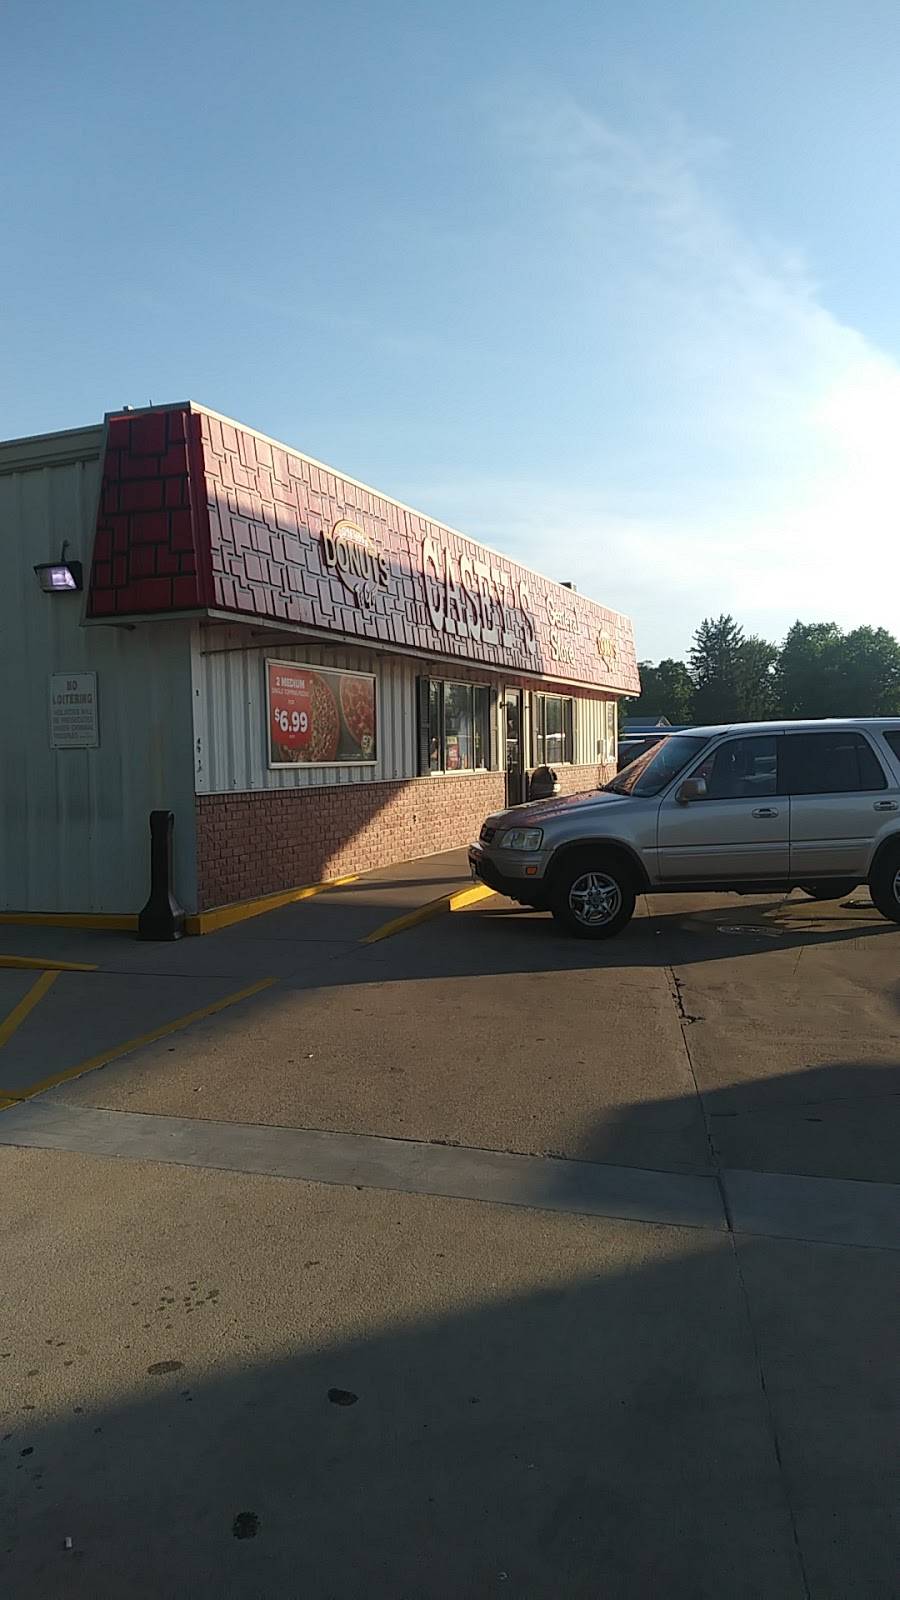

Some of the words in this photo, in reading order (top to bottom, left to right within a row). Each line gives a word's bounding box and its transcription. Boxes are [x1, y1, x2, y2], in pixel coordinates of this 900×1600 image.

[320, 530, 389, 588] DONUTS
[422, 536, 538, 656] CASEY'S
[66, 680, 78, 691] NO
[275, 676, 281, 687] 2
[281, 676, 305, 689] MEDIUM
[53, 693, 93, 705] LOITERING
[274, 707, 308, 733] $6.99
